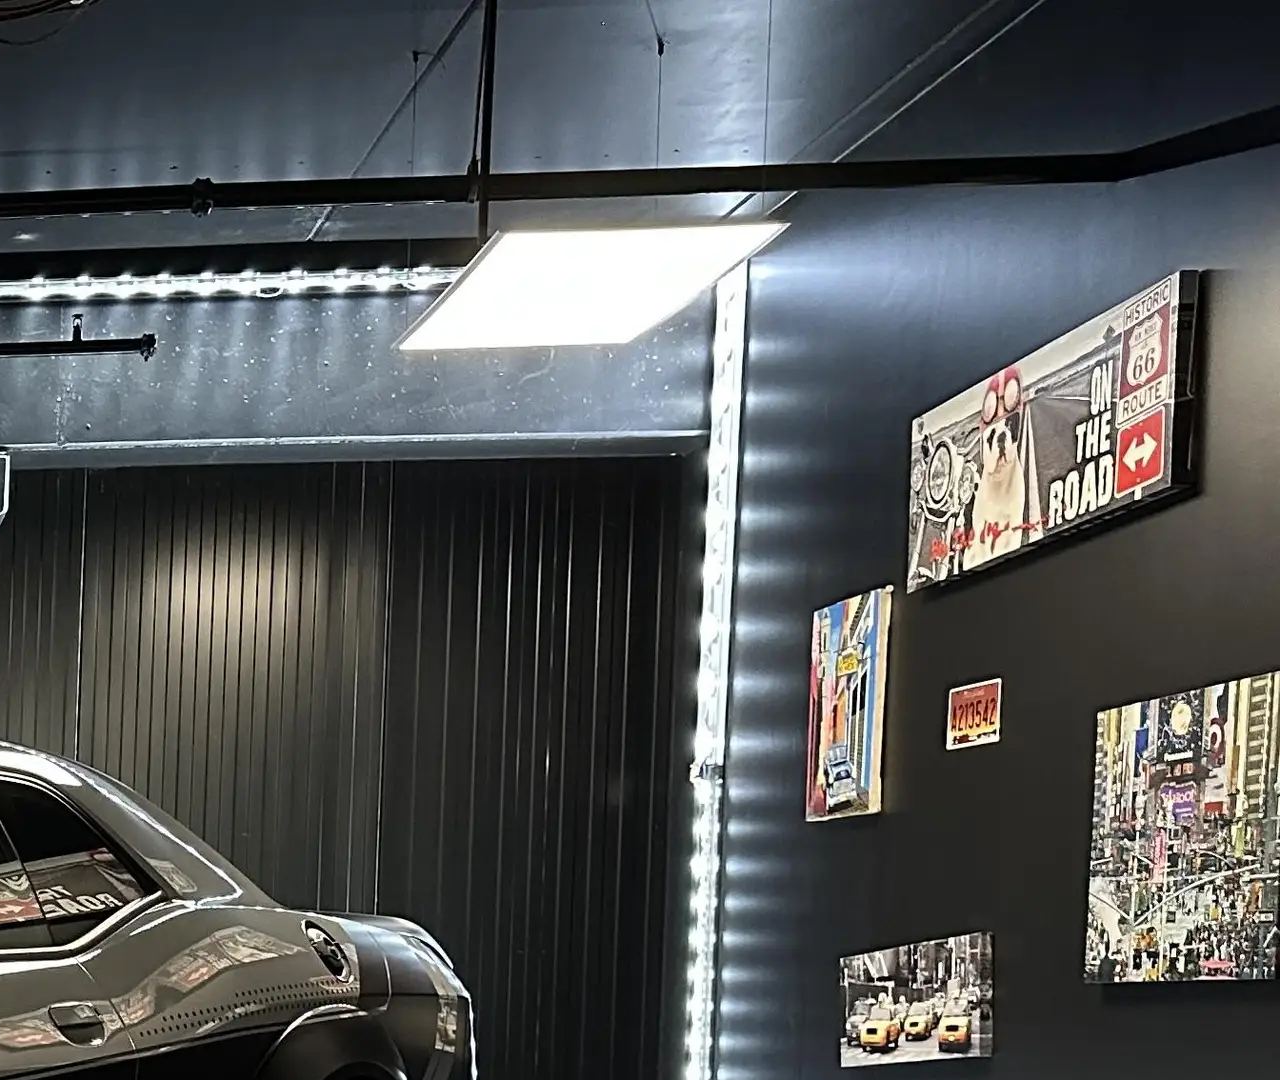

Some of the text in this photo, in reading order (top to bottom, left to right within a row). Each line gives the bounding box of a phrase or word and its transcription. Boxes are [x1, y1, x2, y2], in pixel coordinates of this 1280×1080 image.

[1125, 284, 1169, 327] HISTORIC
[1090, 359, 1113, 416] ON
[1132, 347, 1156, 380] 66
[1122, 381, 1162, 418] ROUTE
[1075, 410, 1111, 464] THE
[1048, 453, 1114, 529] ROAD
